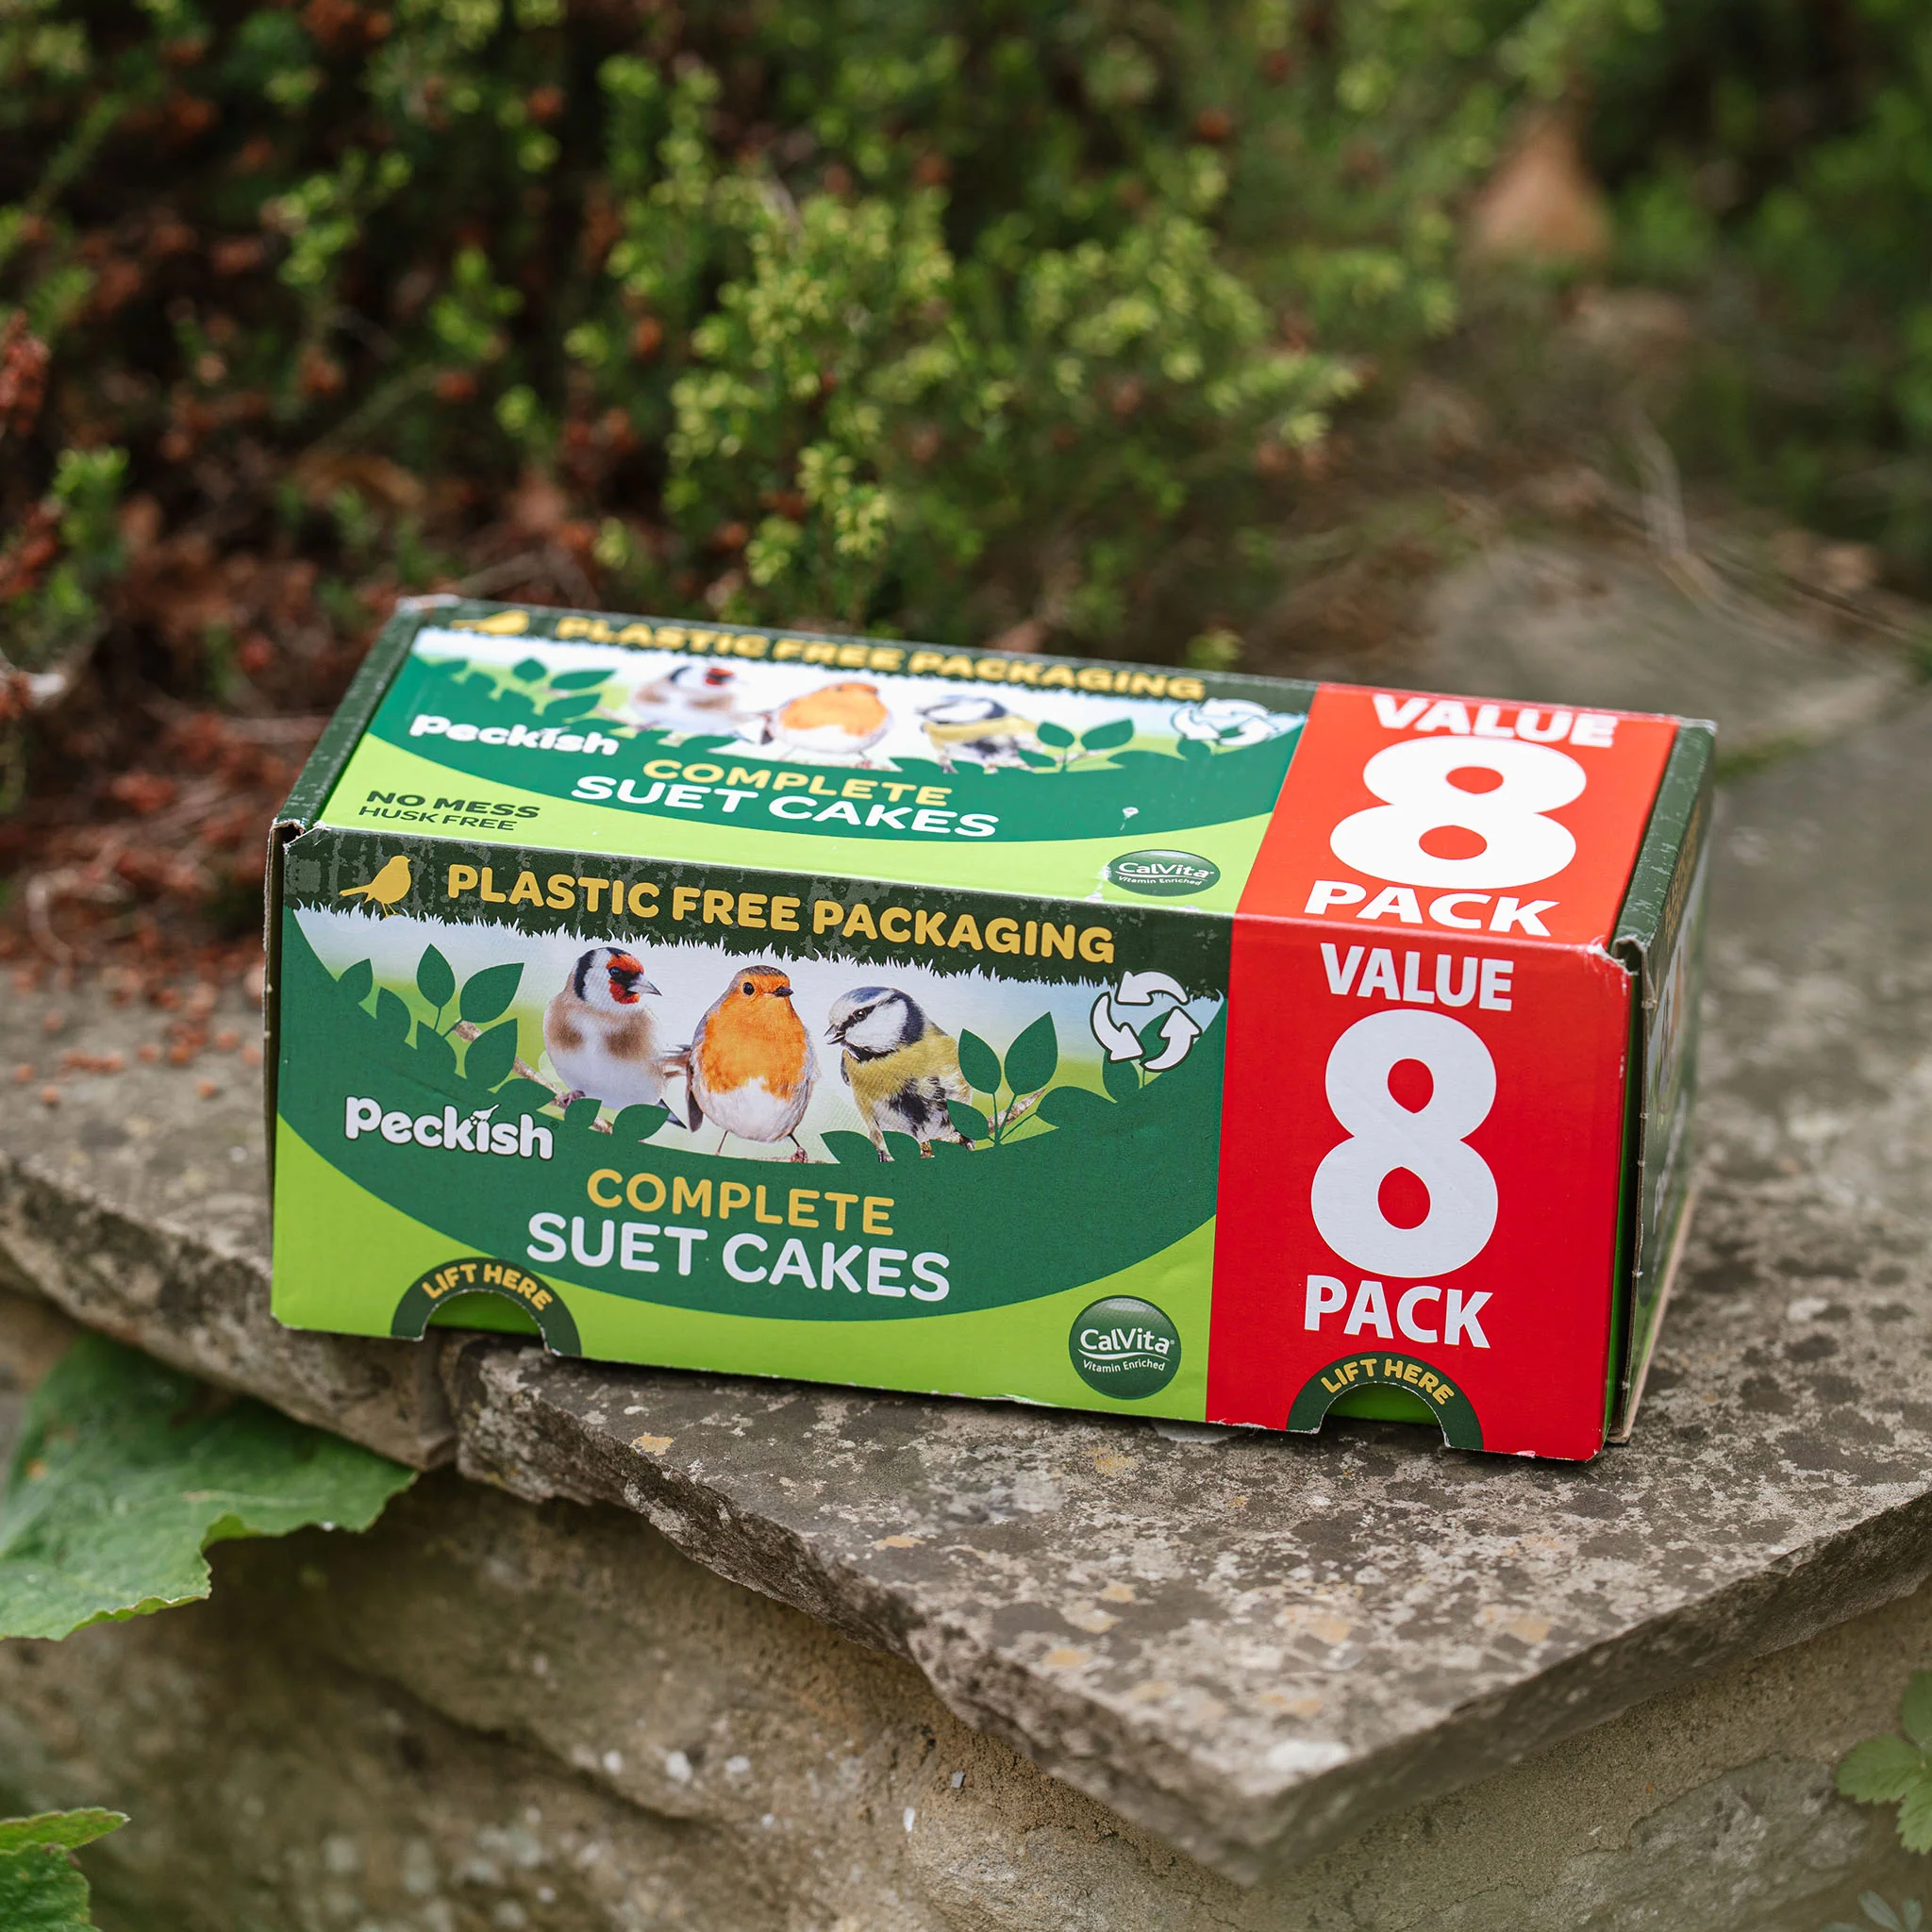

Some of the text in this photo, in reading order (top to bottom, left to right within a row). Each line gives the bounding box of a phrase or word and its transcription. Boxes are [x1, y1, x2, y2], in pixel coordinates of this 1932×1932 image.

[555, 615, 1207, 700] PLASTIC FREE PACKAGING
[408, 714, 620, 756] Peckish
[1372, 693, 1620, 748] VALUE
[366, 790, 541, 819] NO MESS
[571, 775, 1000, 838] SUET CAKES
[643, 758, 953, 807] COMPLETE
[358, 806, 518, 831] HUSK FREE
[1329, 735, 1587, 890] 8
[1119, 861, 1208, 878] CalVita
[1119, 875, 1203, 886] Vitamin Enriched
[447, 863, 1116, 963] PLASTIC FREE PACKAGING
[1304, 880, 1560, 937] PACK
[1320, 942, 1515, 1011] VALUE
[344, 1095, 555, 1160] Peckish
[1310, 1008, 1499, 1278] 8
[587, 1168, 895, 1236] COMPLETE
[525, 1212, 951, 1303] SUET CAKES
[421, 1262, 553, 1311] LIFT HERE
[1304, 1274, 1494, 1350] PACK
[1078, 1326, 1171, 1355] CalVita
[1083, 1358, 1165, 1373] Vitamin Enriched
[1320, 1357, 1456, 1406] LIFT HERE
